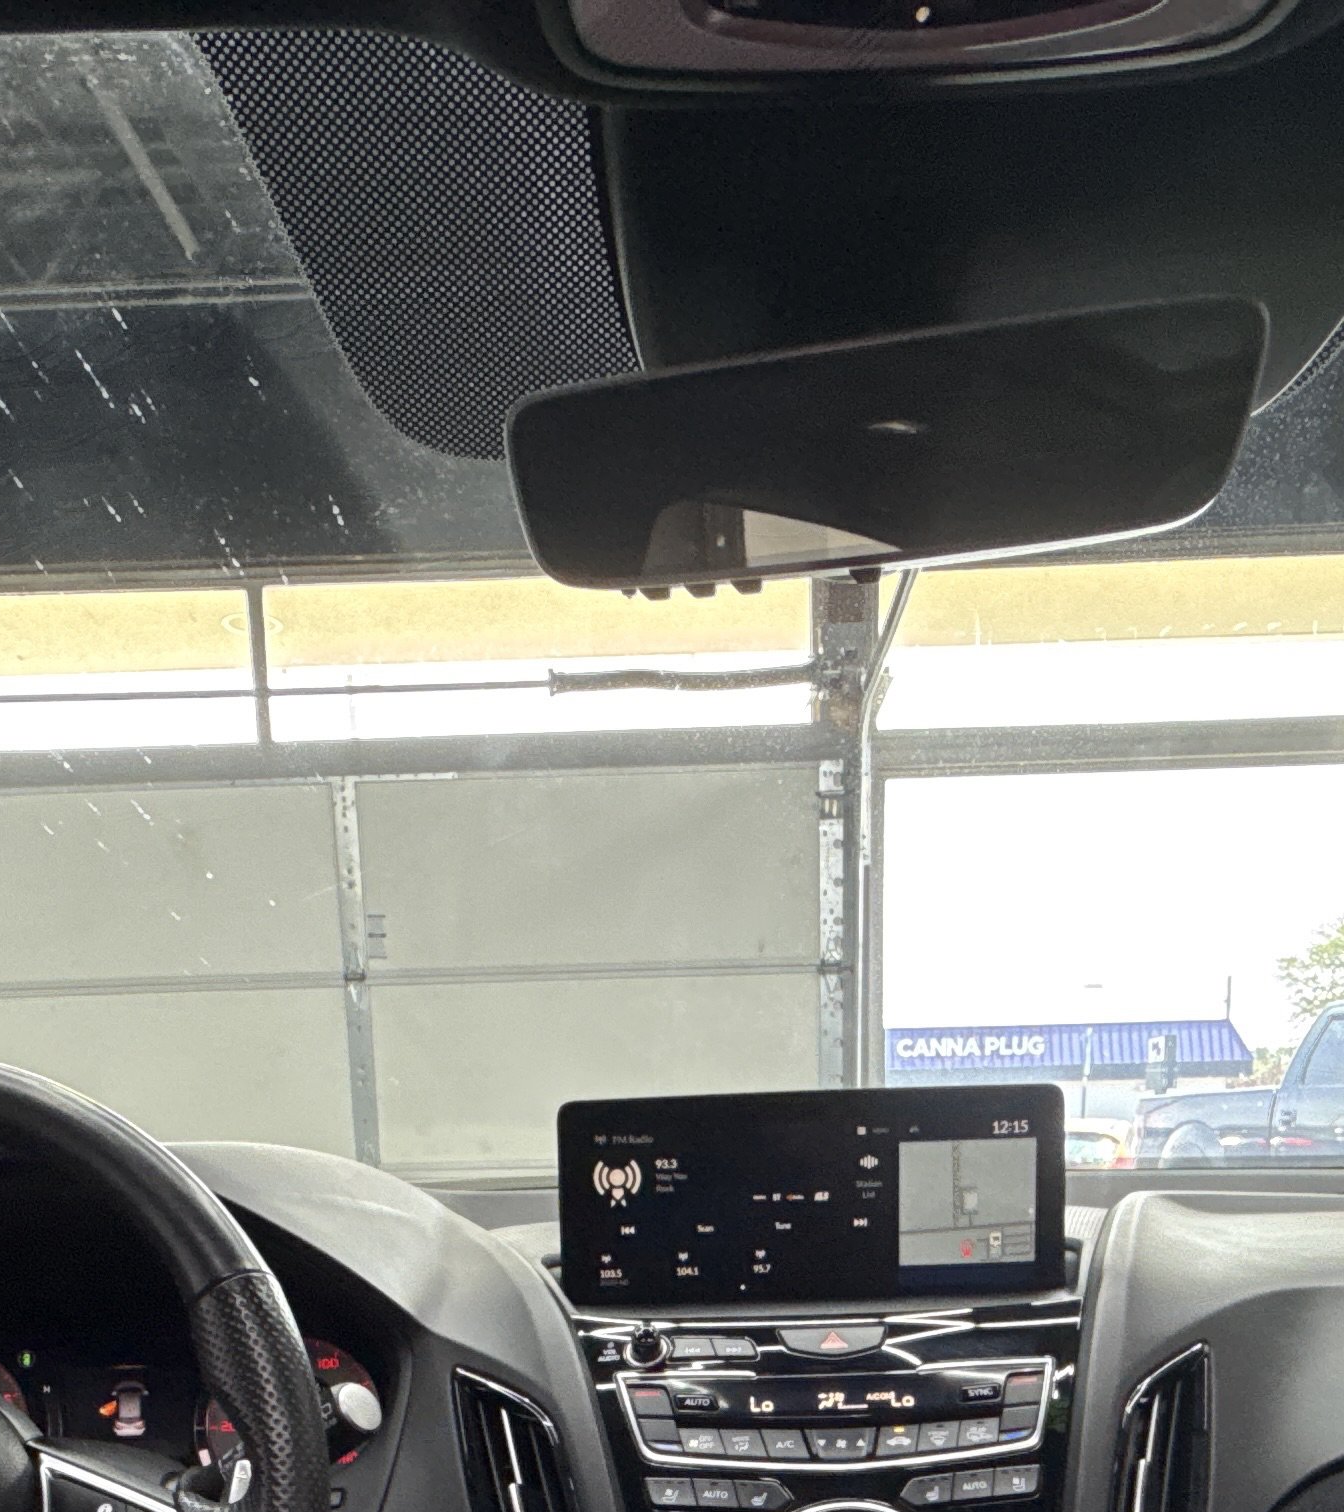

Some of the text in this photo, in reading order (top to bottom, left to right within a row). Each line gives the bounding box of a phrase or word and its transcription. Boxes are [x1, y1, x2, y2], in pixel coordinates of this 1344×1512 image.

[896, 1036, 1046, 1057] CANNA PLUG
[992, 1120, 1029, 1134] 12:15
[967, 1388, 994, 1397] SYNC
[684, 1398, 710, 1407] AUTO
[775, 1440, 795, 1449] A/C
[962, 1482, 987, 1491] AUTO
[702, 1490, 728, 1499] AUTO
